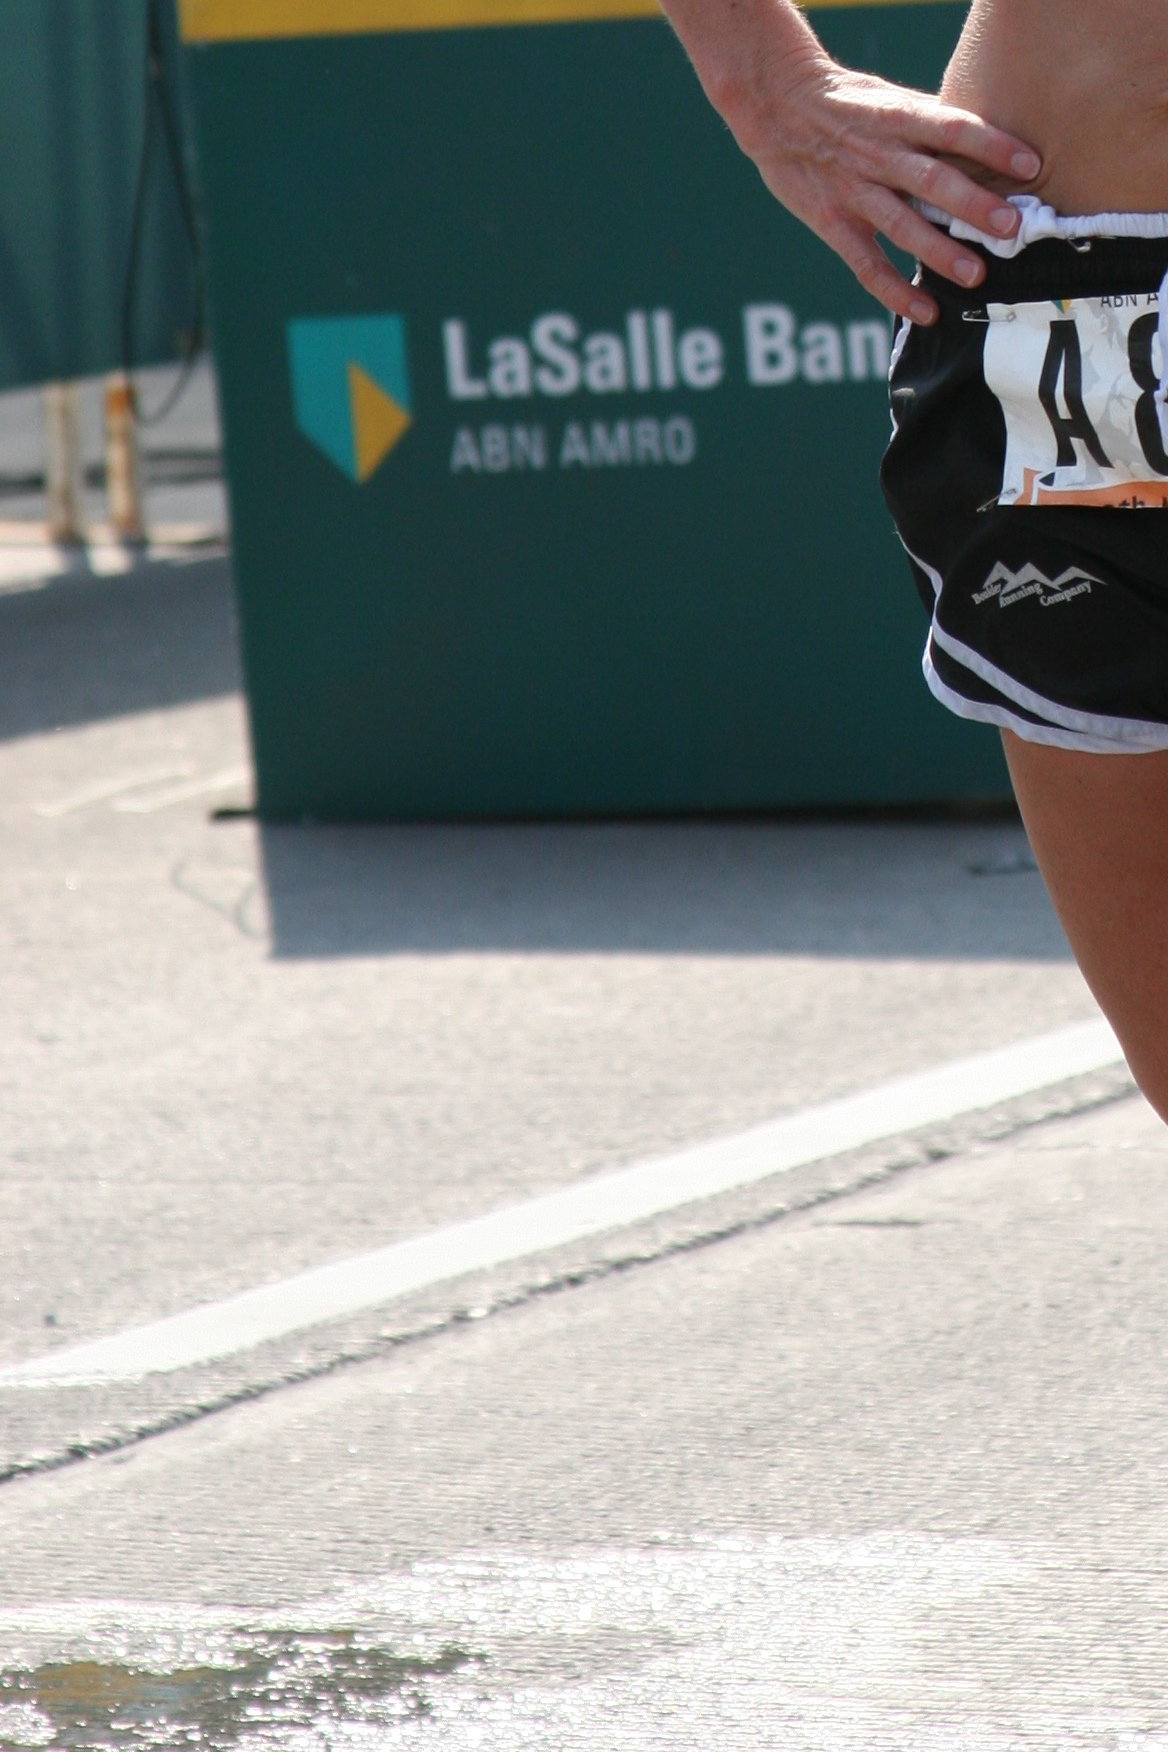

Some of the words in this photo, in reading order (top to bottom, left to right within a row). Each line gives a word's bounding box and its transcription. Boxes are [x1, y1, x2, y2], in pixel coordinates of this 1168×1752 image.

[442, 307, 723, 400] LaSalle
[449, 424, 546, 474] ABN
[558, 416, 696, 469] AMRO
